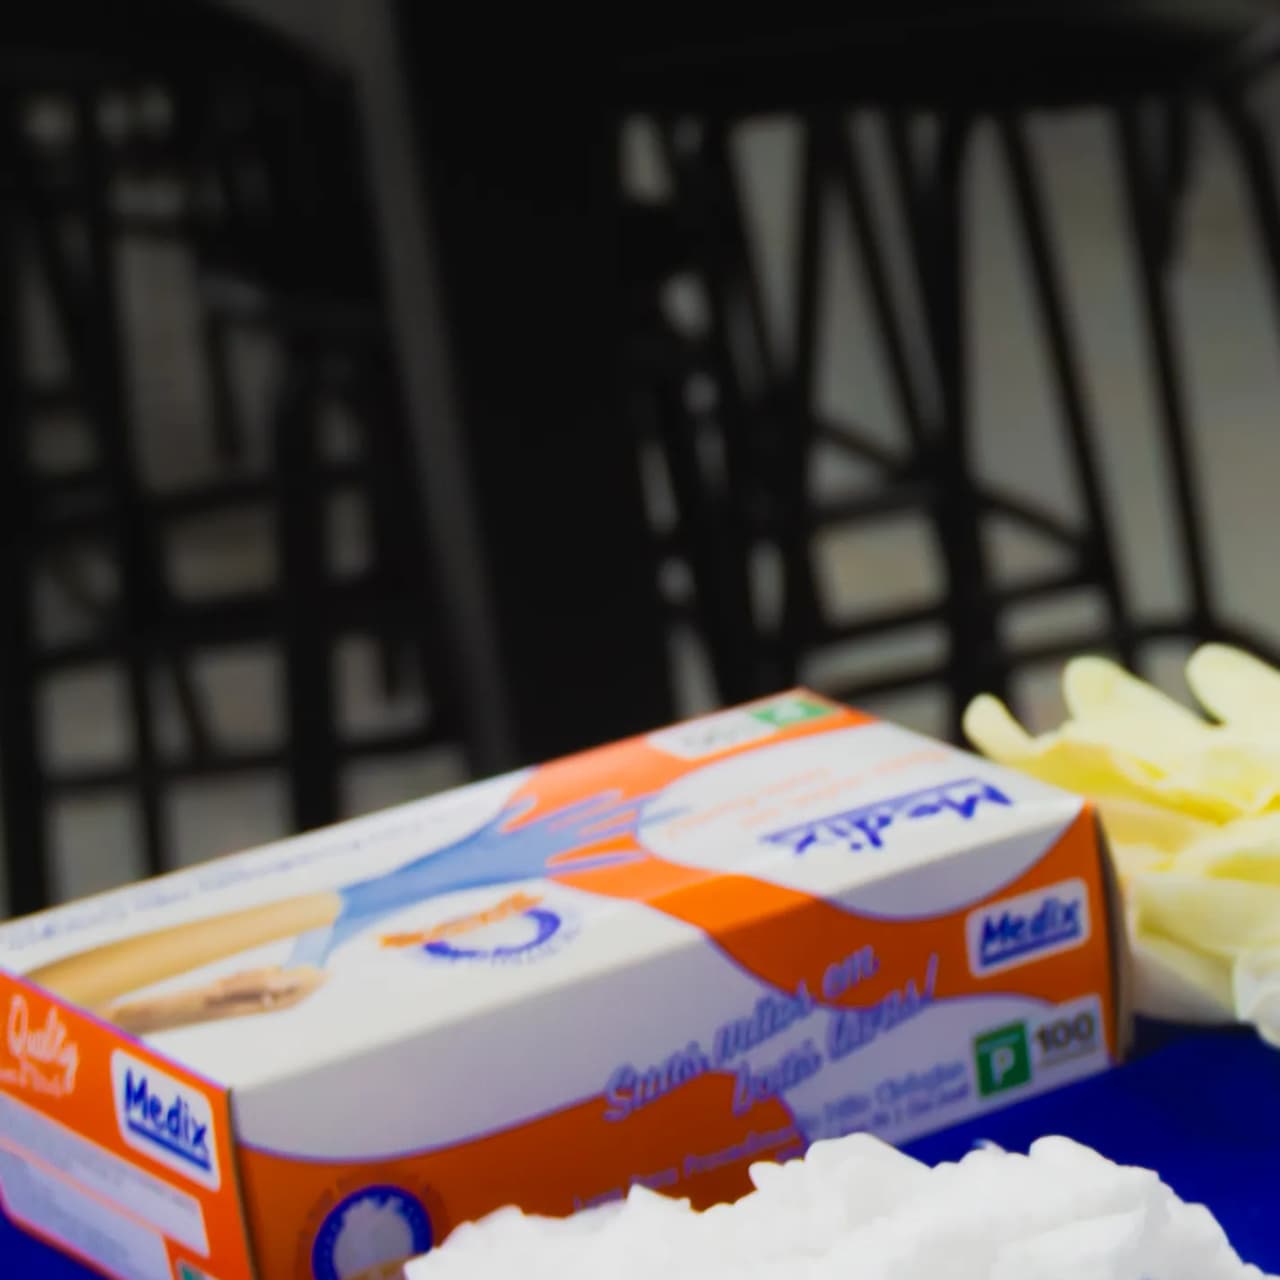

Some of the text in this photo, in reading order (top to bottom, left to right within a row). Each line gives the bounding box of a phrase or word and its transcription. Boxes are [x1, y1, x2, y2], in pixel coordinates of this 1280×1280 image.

[979, 897, 1082, 958] Medix
[1034, 1013, 1096, 1053] 100
[123, 1066, 211, 1158] Medix
